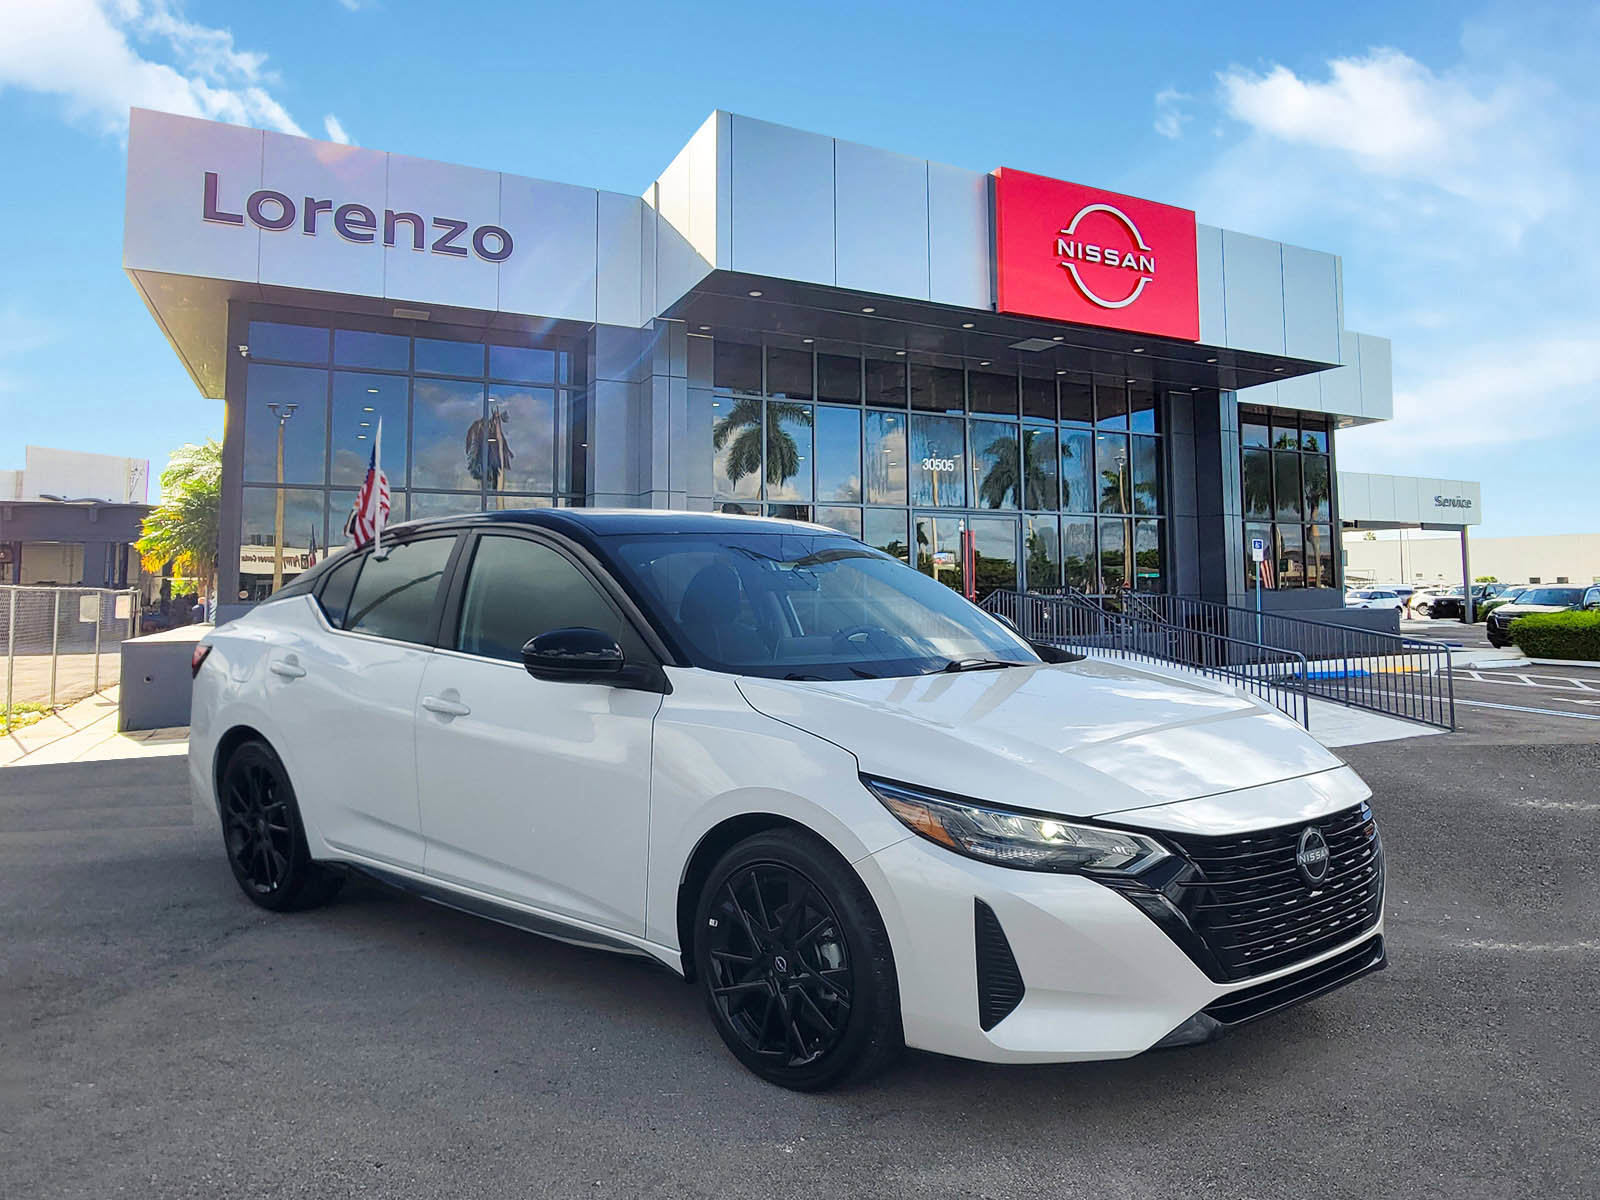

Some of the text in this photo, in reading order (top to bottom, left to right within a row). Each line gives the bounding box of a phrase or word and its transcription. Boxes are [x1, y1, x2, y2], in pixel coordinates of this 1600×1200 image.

[203, 171, 514, 262] Lorenzo
[1057, 238, 1155, 273] NISSAN
[922, 458, 955, 471] 30505
[1434, 495, 1472, 508] Service
